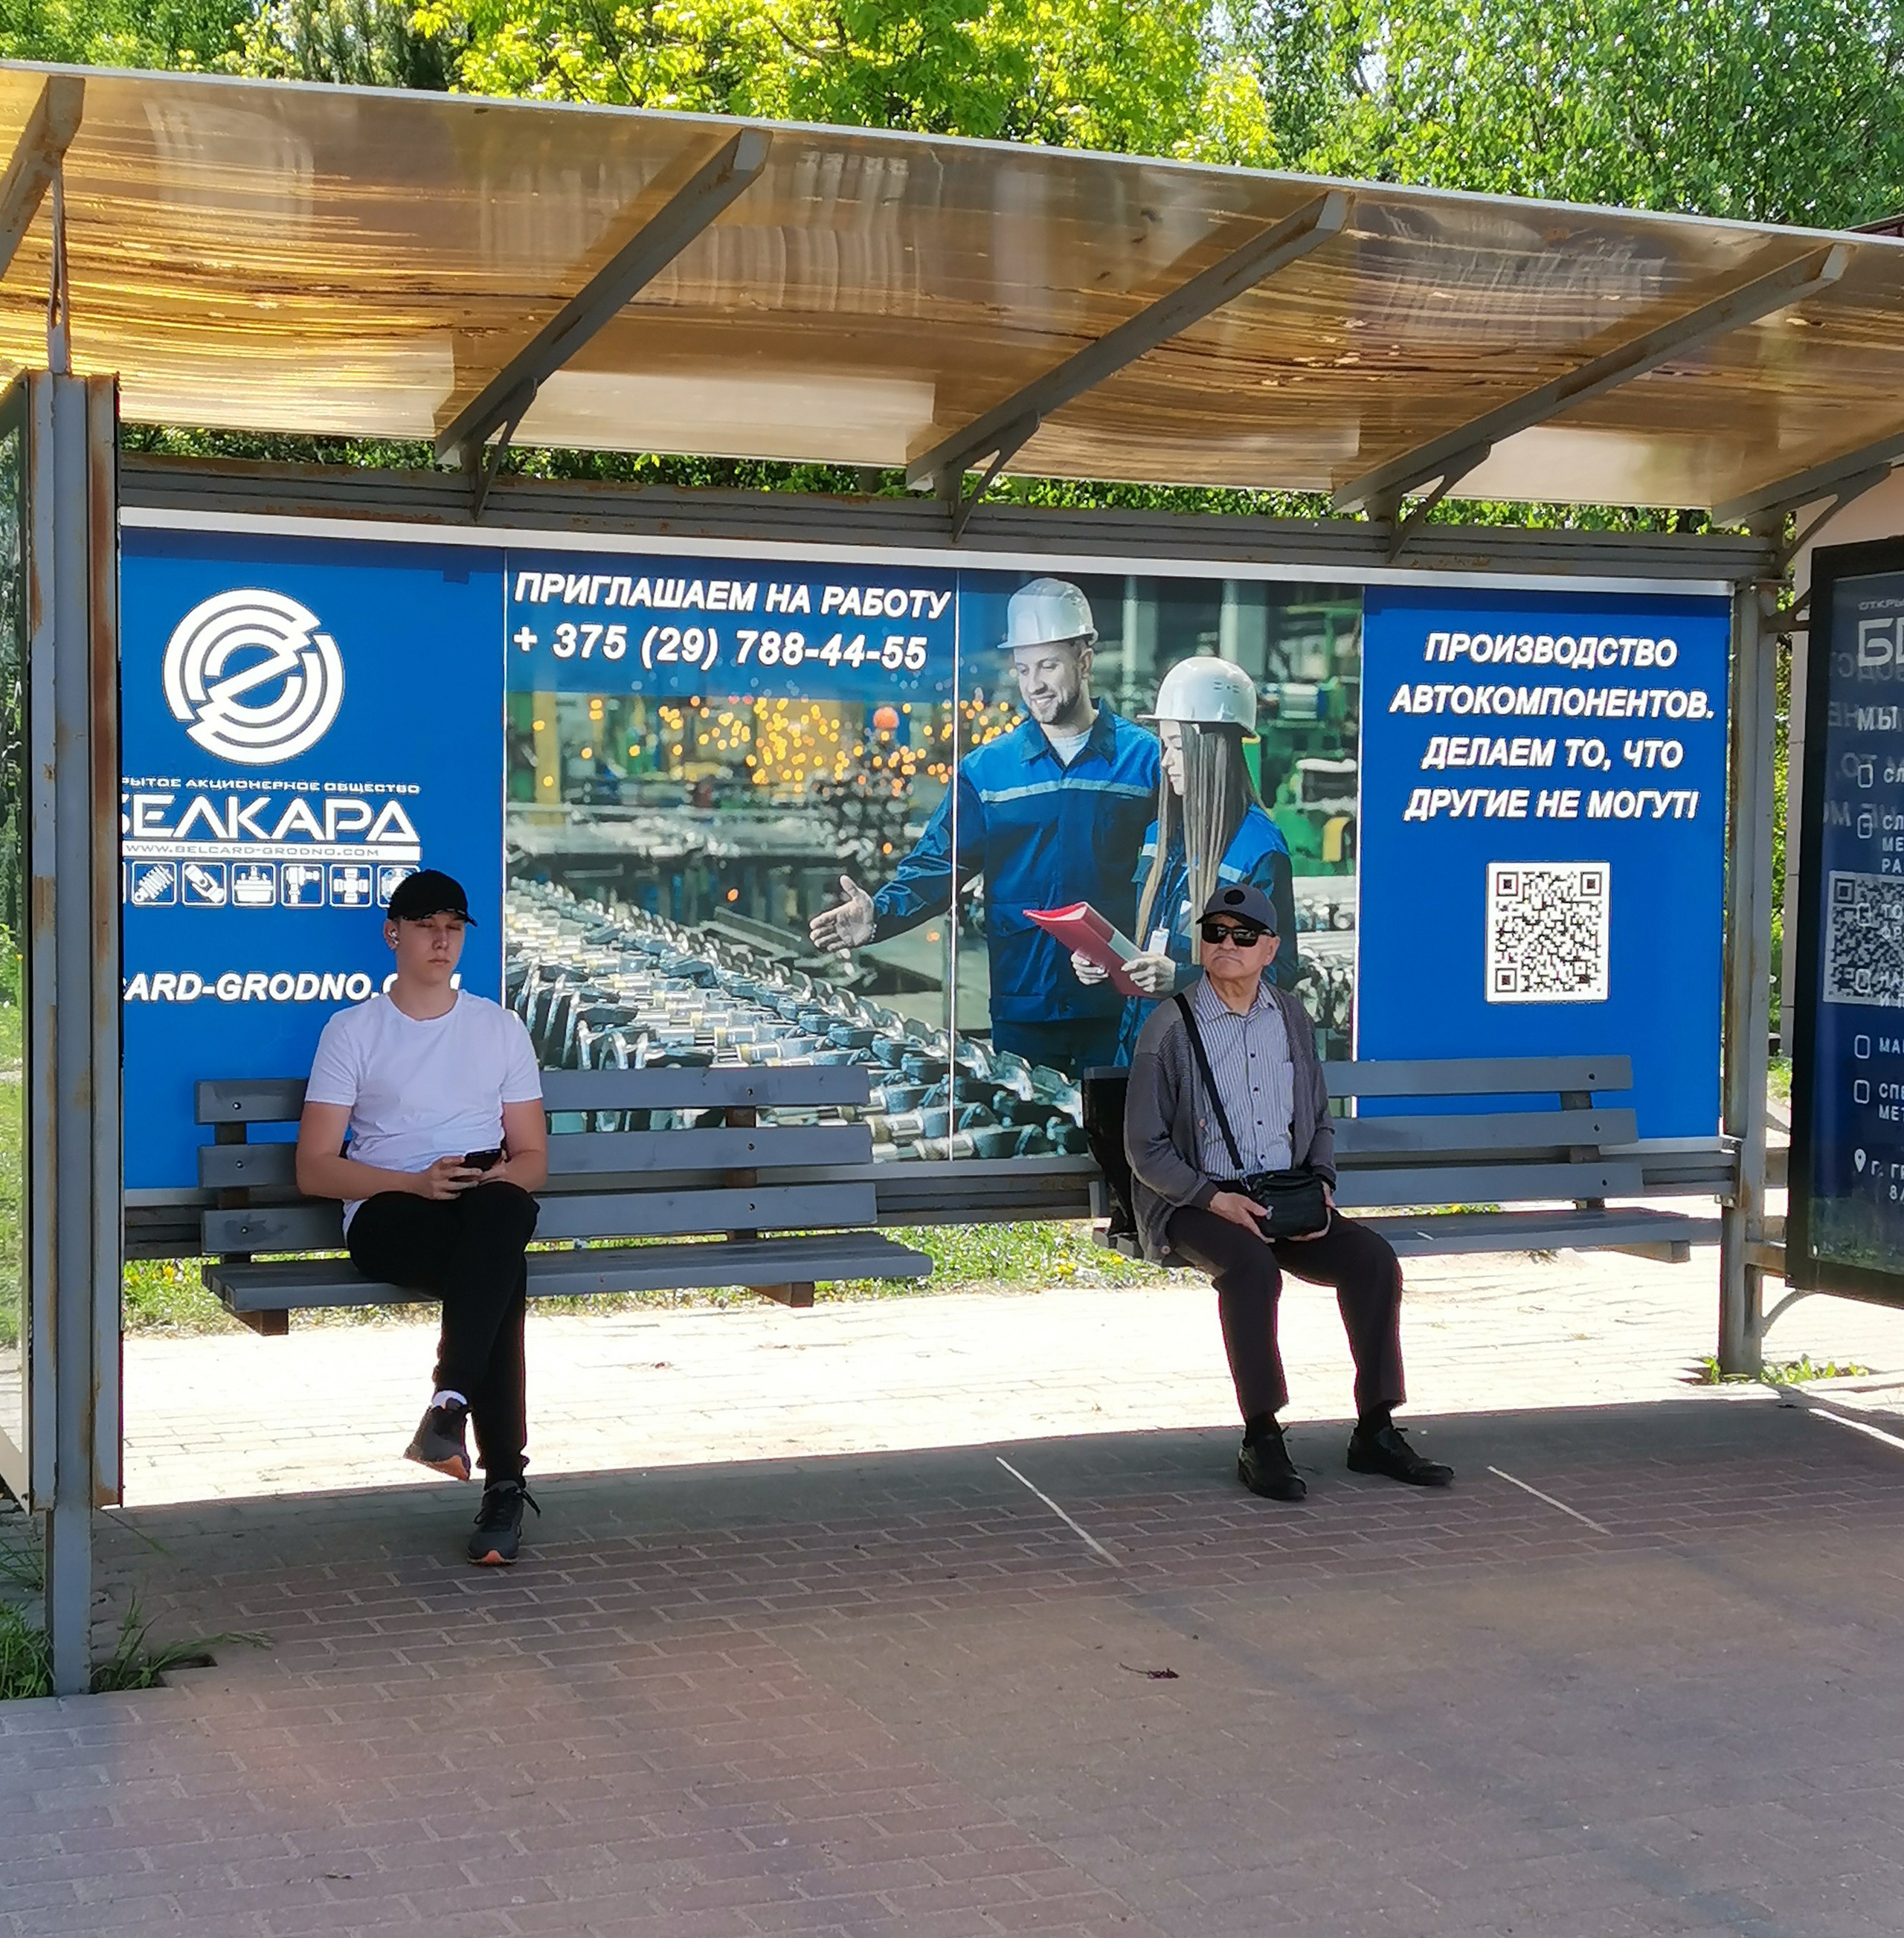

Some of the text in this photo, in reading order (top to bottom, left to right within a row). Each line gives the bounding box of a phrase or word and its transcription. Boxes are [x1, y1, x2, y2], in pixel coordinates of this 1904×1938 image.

[514, 572, 951, 619] ПРИГЛАШАЕМ НА РАБОТУ
[552, 622, 627, 660] 375
[641, 625, 718, 670] (29)
[736, 630, 927, 669] 788-44-55
[1424, 633, 1678, 669] ПРОИЗВОДСТВО
[1389, 684, 1714, 718] АВТОКОМПОНЕНТОВ.
[1421, 737, 1683, 770] ДЕЛАЕМ ТО, ЧТО
[185, 779, 320, 792] АКЦИОНЕРНОЕ
[324, 781, 421, 794] ОБЩЕСТВО
[122, 793, 421, 842] ЕЛКАРД
[1403, 788, 1700, 821] ДРУГИЕ НЕ МОГУТ!
